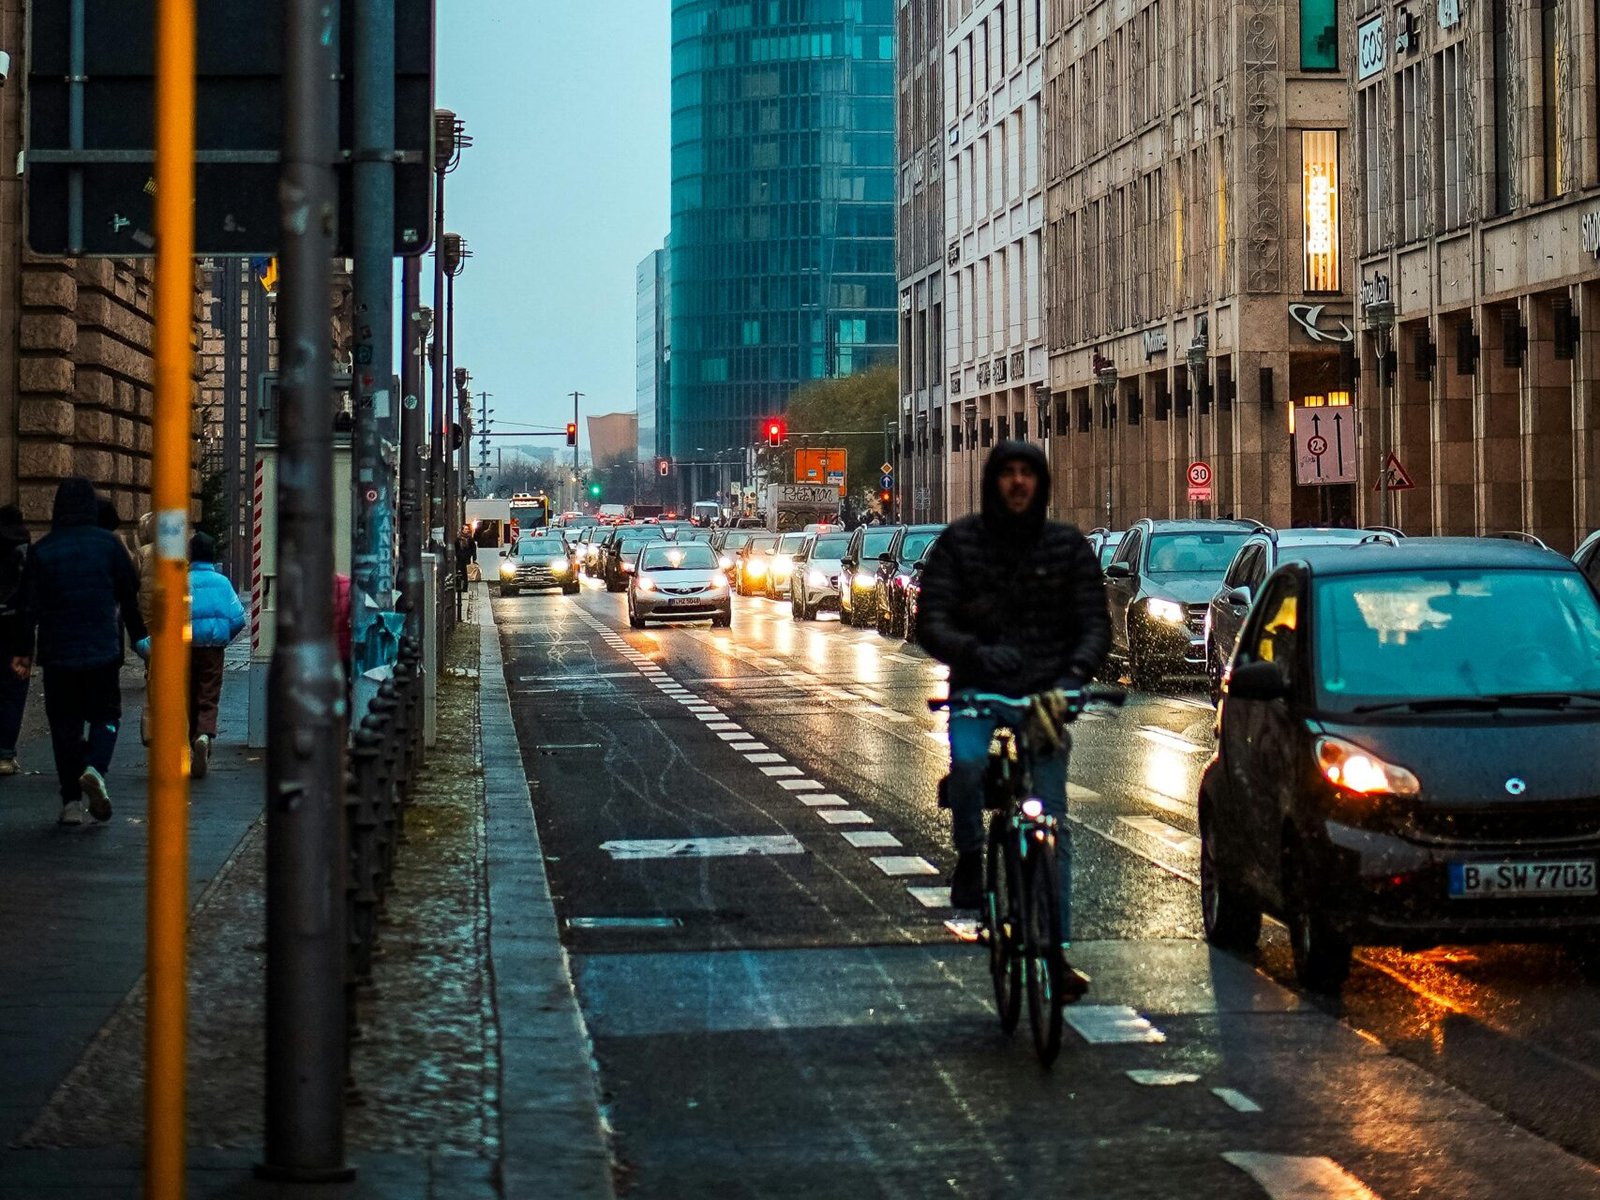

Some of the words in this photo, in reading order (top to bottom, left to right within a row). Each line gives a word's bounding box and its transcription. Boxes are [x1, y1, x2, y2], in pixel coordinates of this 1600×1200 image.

[1192, 468, 1207, 480] 30
[1465, 867, 1480, 889] B
[1497, 866, 1527, 889] SW
[1533, 864, 1593, 889] 7703
